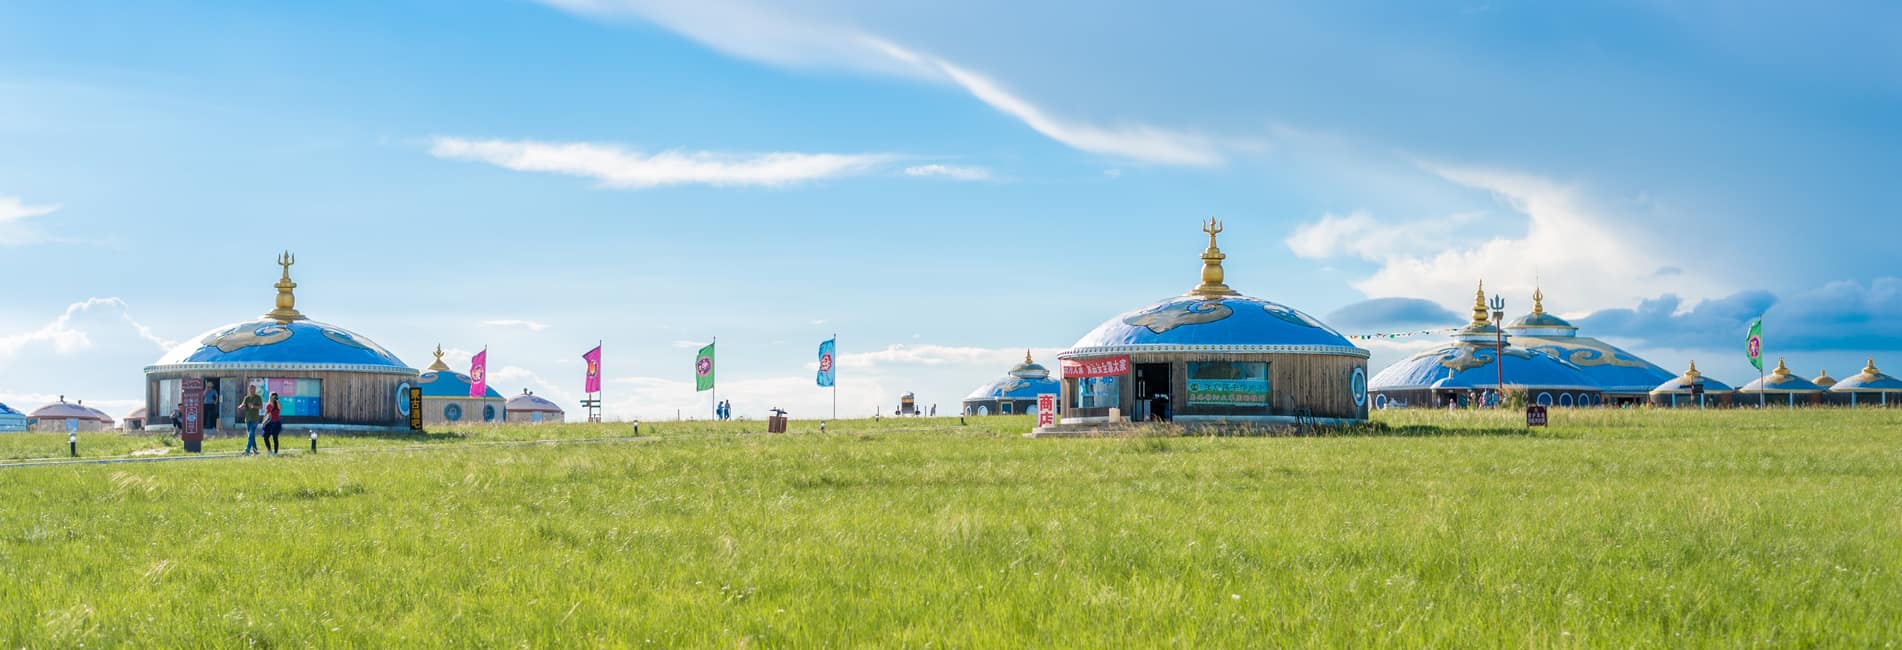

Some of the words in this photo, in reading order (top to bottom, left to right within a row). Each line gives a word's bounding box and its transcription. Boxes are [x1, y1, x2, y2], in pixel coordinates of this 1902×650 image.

[411, 389, 420, 429] 蒙古酒吧
[1039, 395, 1053, 427] 商店
